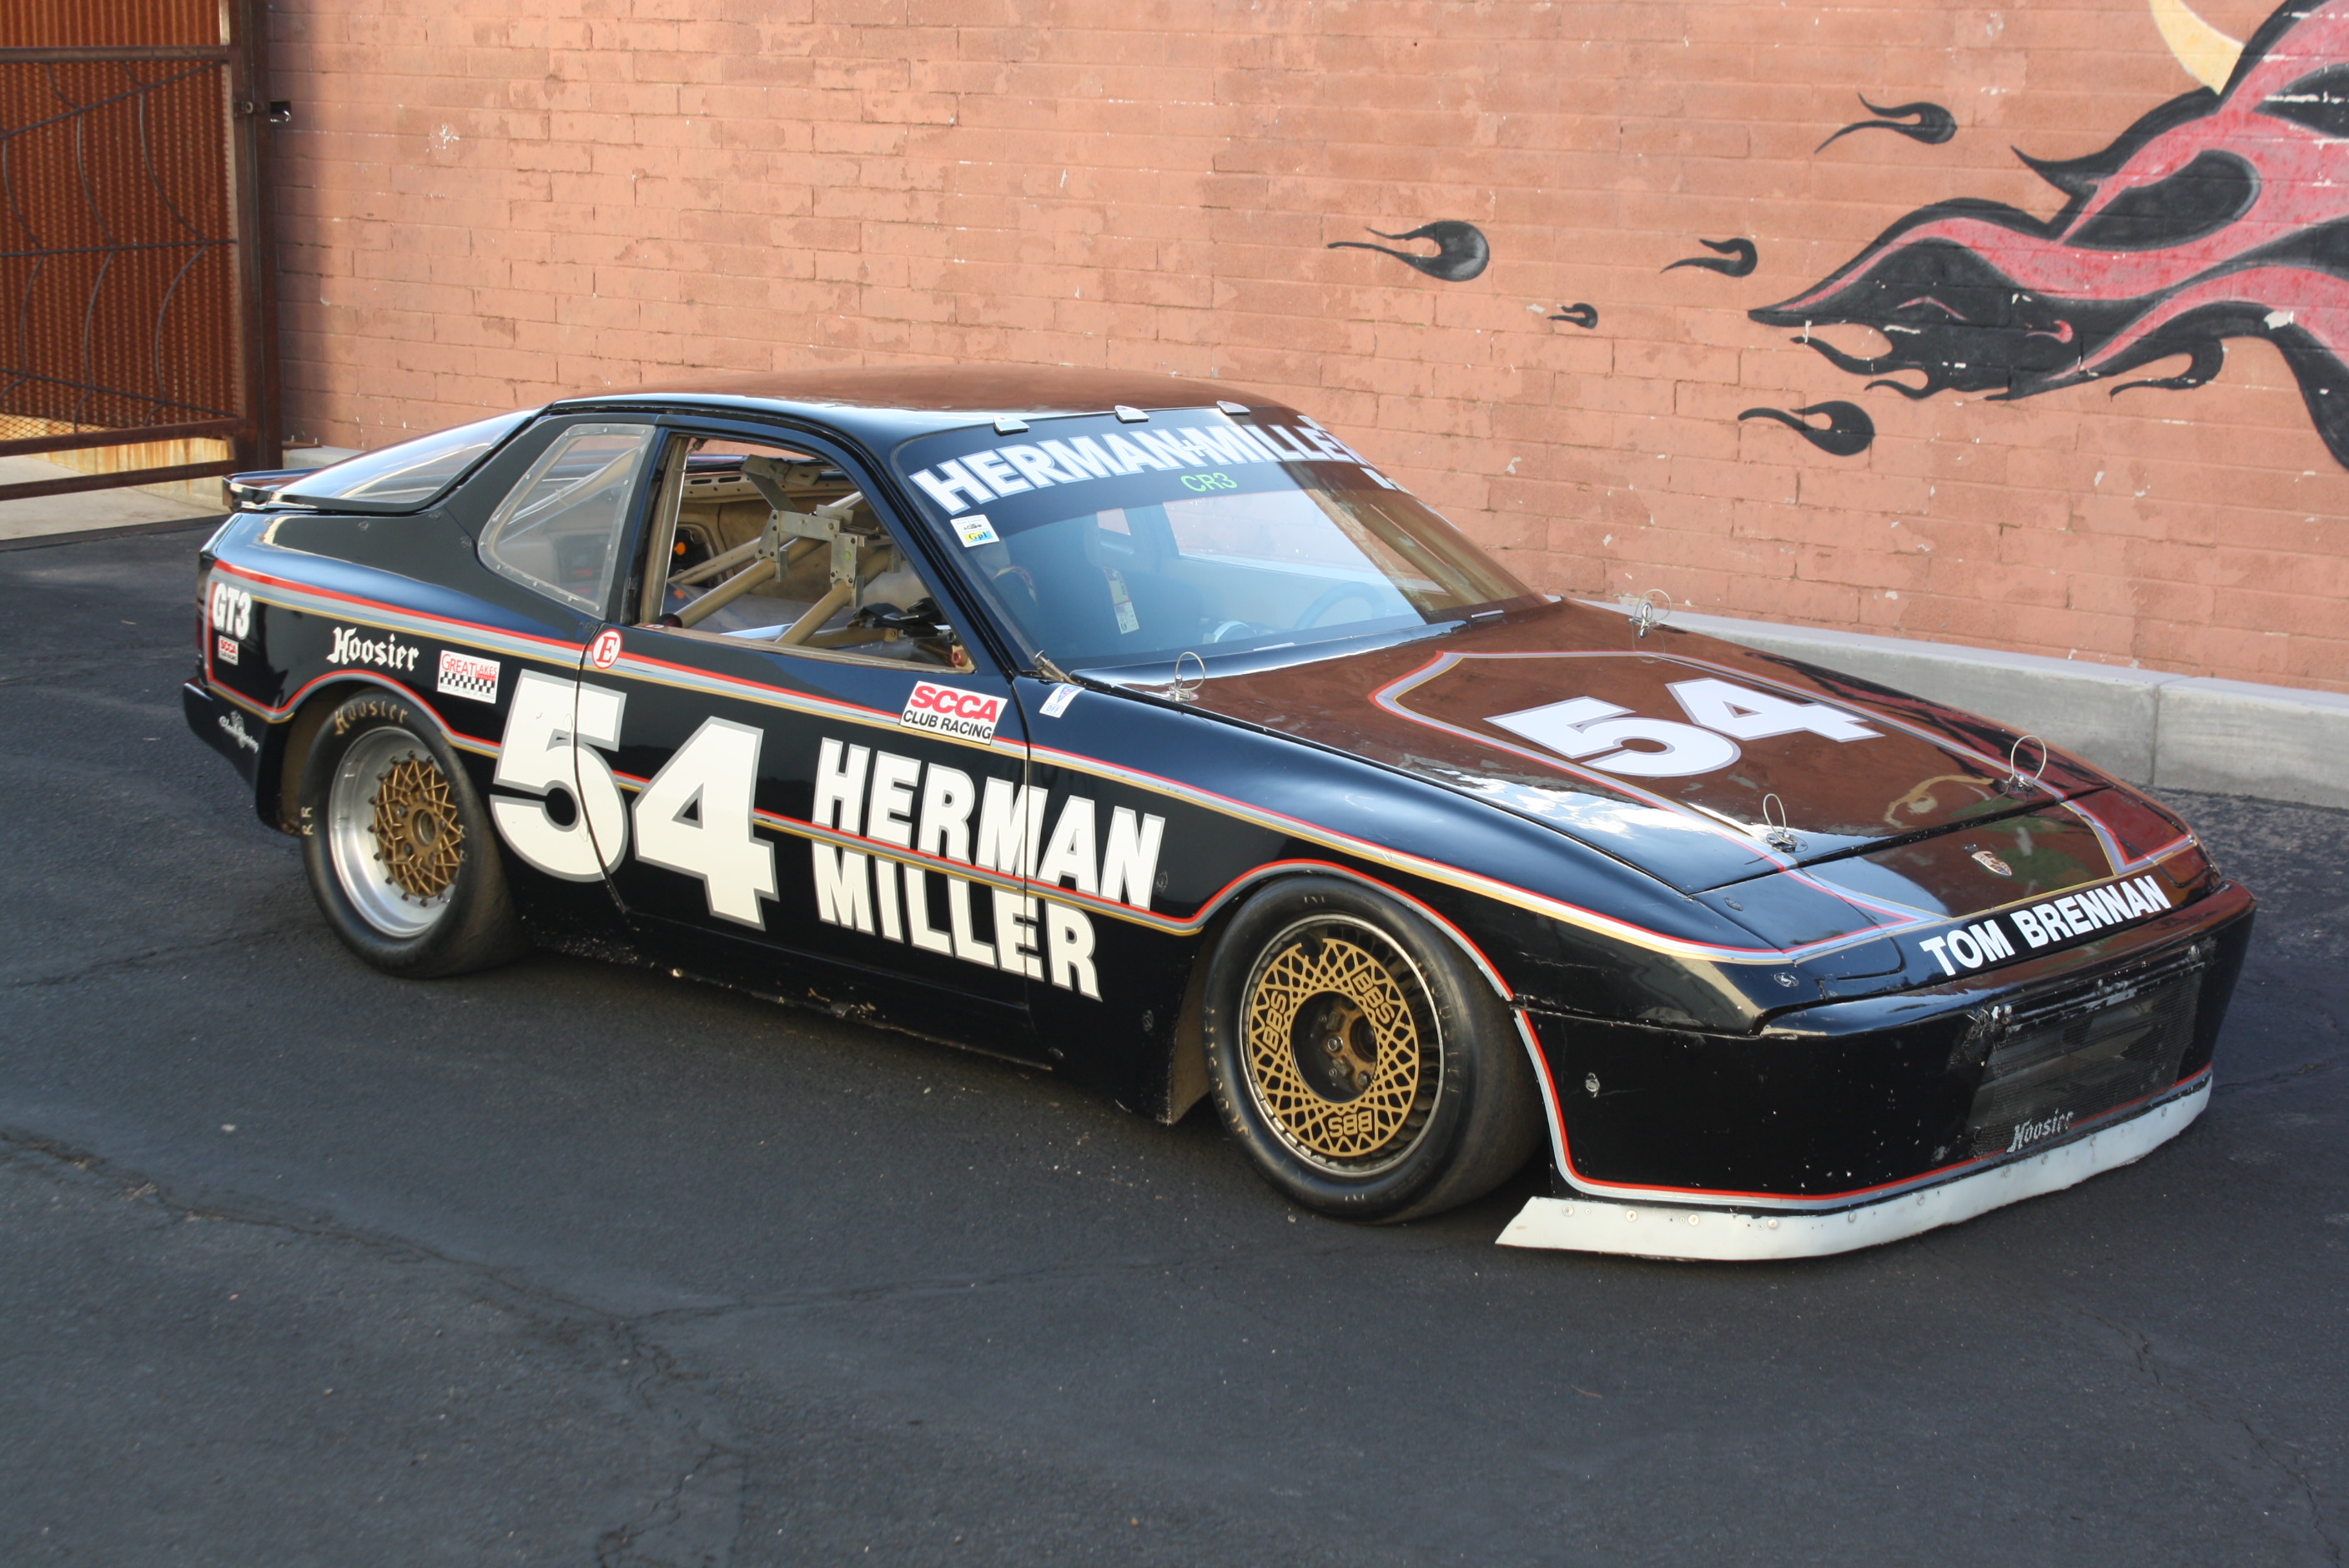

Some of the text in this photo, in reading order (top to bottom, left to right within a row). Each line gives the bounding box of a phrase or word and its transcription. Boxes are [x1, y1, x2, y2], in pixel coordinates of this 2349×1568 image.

[1180, 471, 1238, 493] CR3
[213, 582, 252, 641] GT3
[326, 626, 420, 671] Hoosier
[596, 634, 619, 665] E
[334, 696, 409, 736] Hoosier
[903, 709, 993, 740] CLUB RACING
[910, 685, 998, 723] SCCA
[1046, 705, 1060, 714] OFF
[1481, 676, 1886, 777] 54
[489, 668, 780, 932] 54
[812, 737, 1165, 911] HERMAN
[812, 839, 1102, 1002] MILLER
[1919, 875, 2171, 977] TOM BRENNAN
[1262, 990, 1288, 1052] BBS
[1351, 970, 1396, 1025] BBS
[1327, 1109, 1374, 1138] BBS
